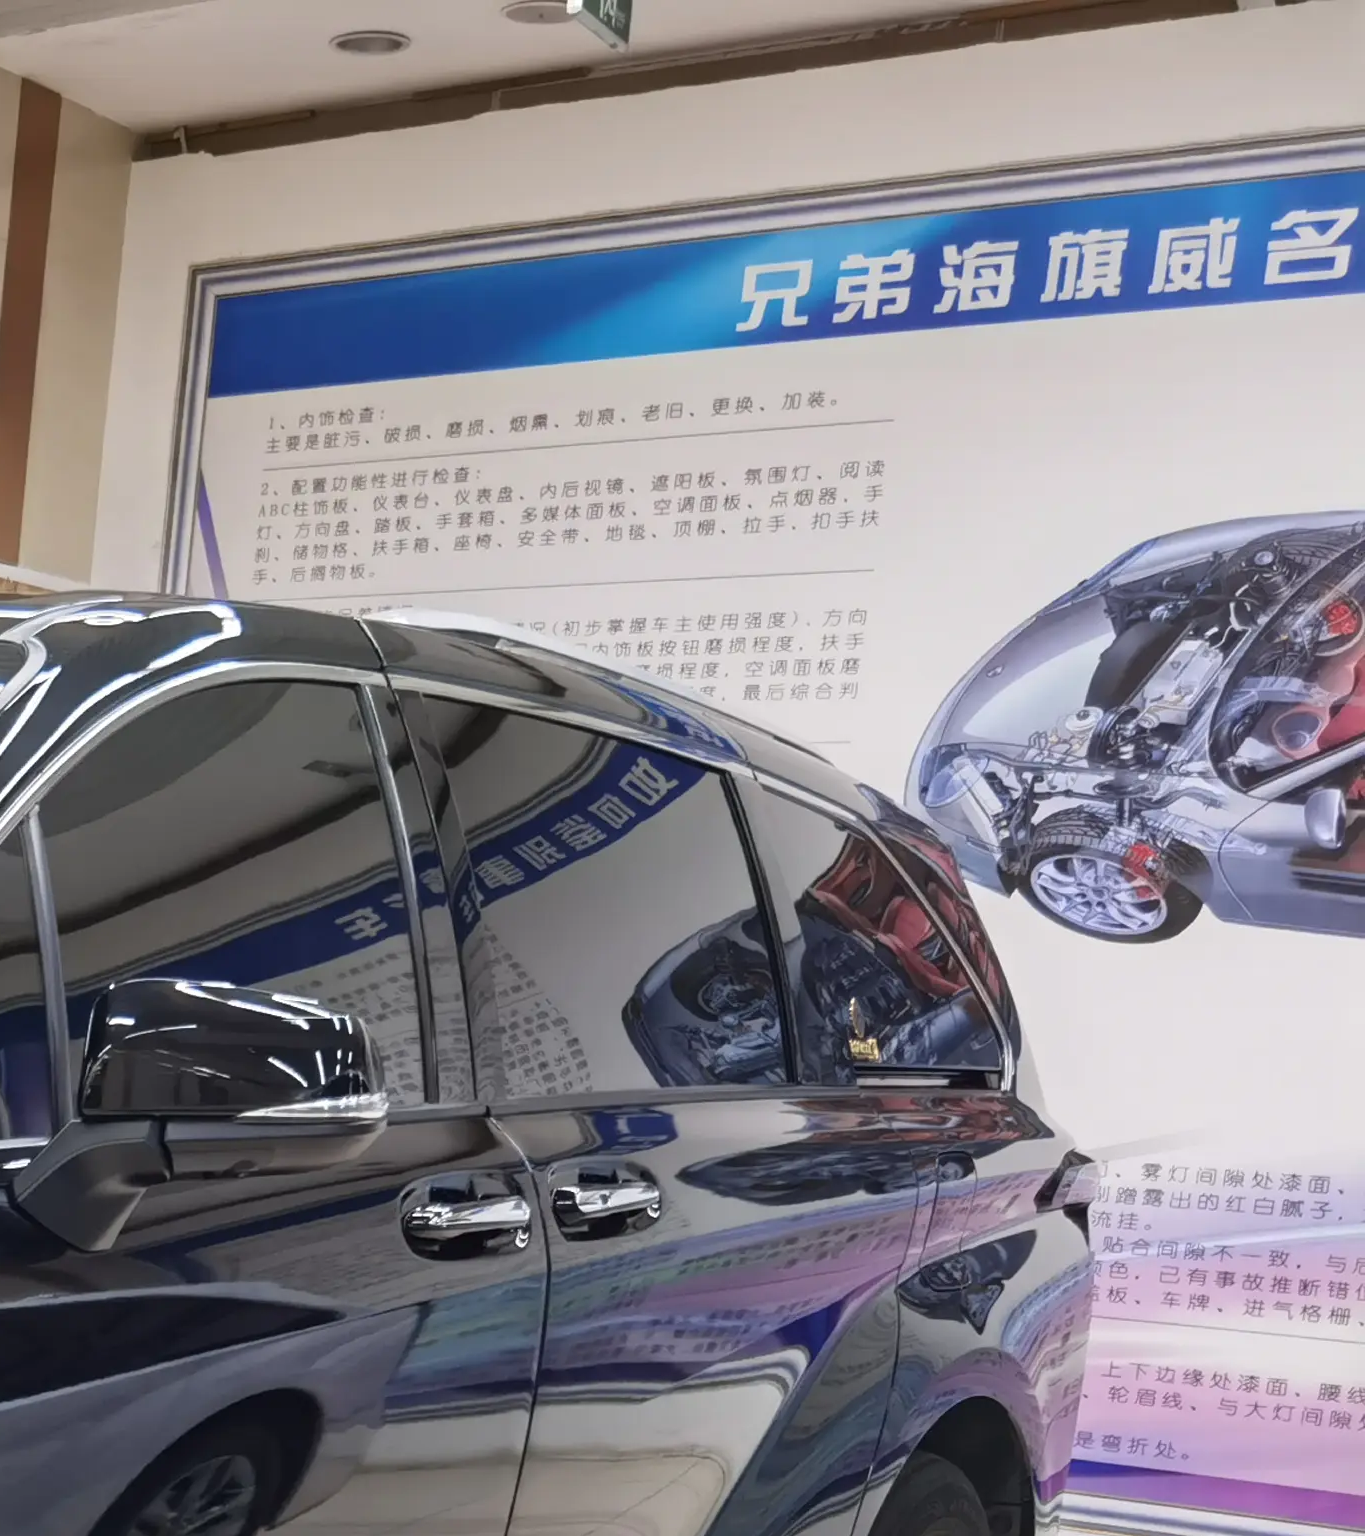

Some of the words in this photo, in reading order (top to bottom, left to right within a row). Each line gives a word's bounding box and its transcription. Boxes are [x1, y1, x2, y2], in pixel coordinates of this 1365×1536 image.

[735, 207, 1360, 333] 兄弟海旗威名
